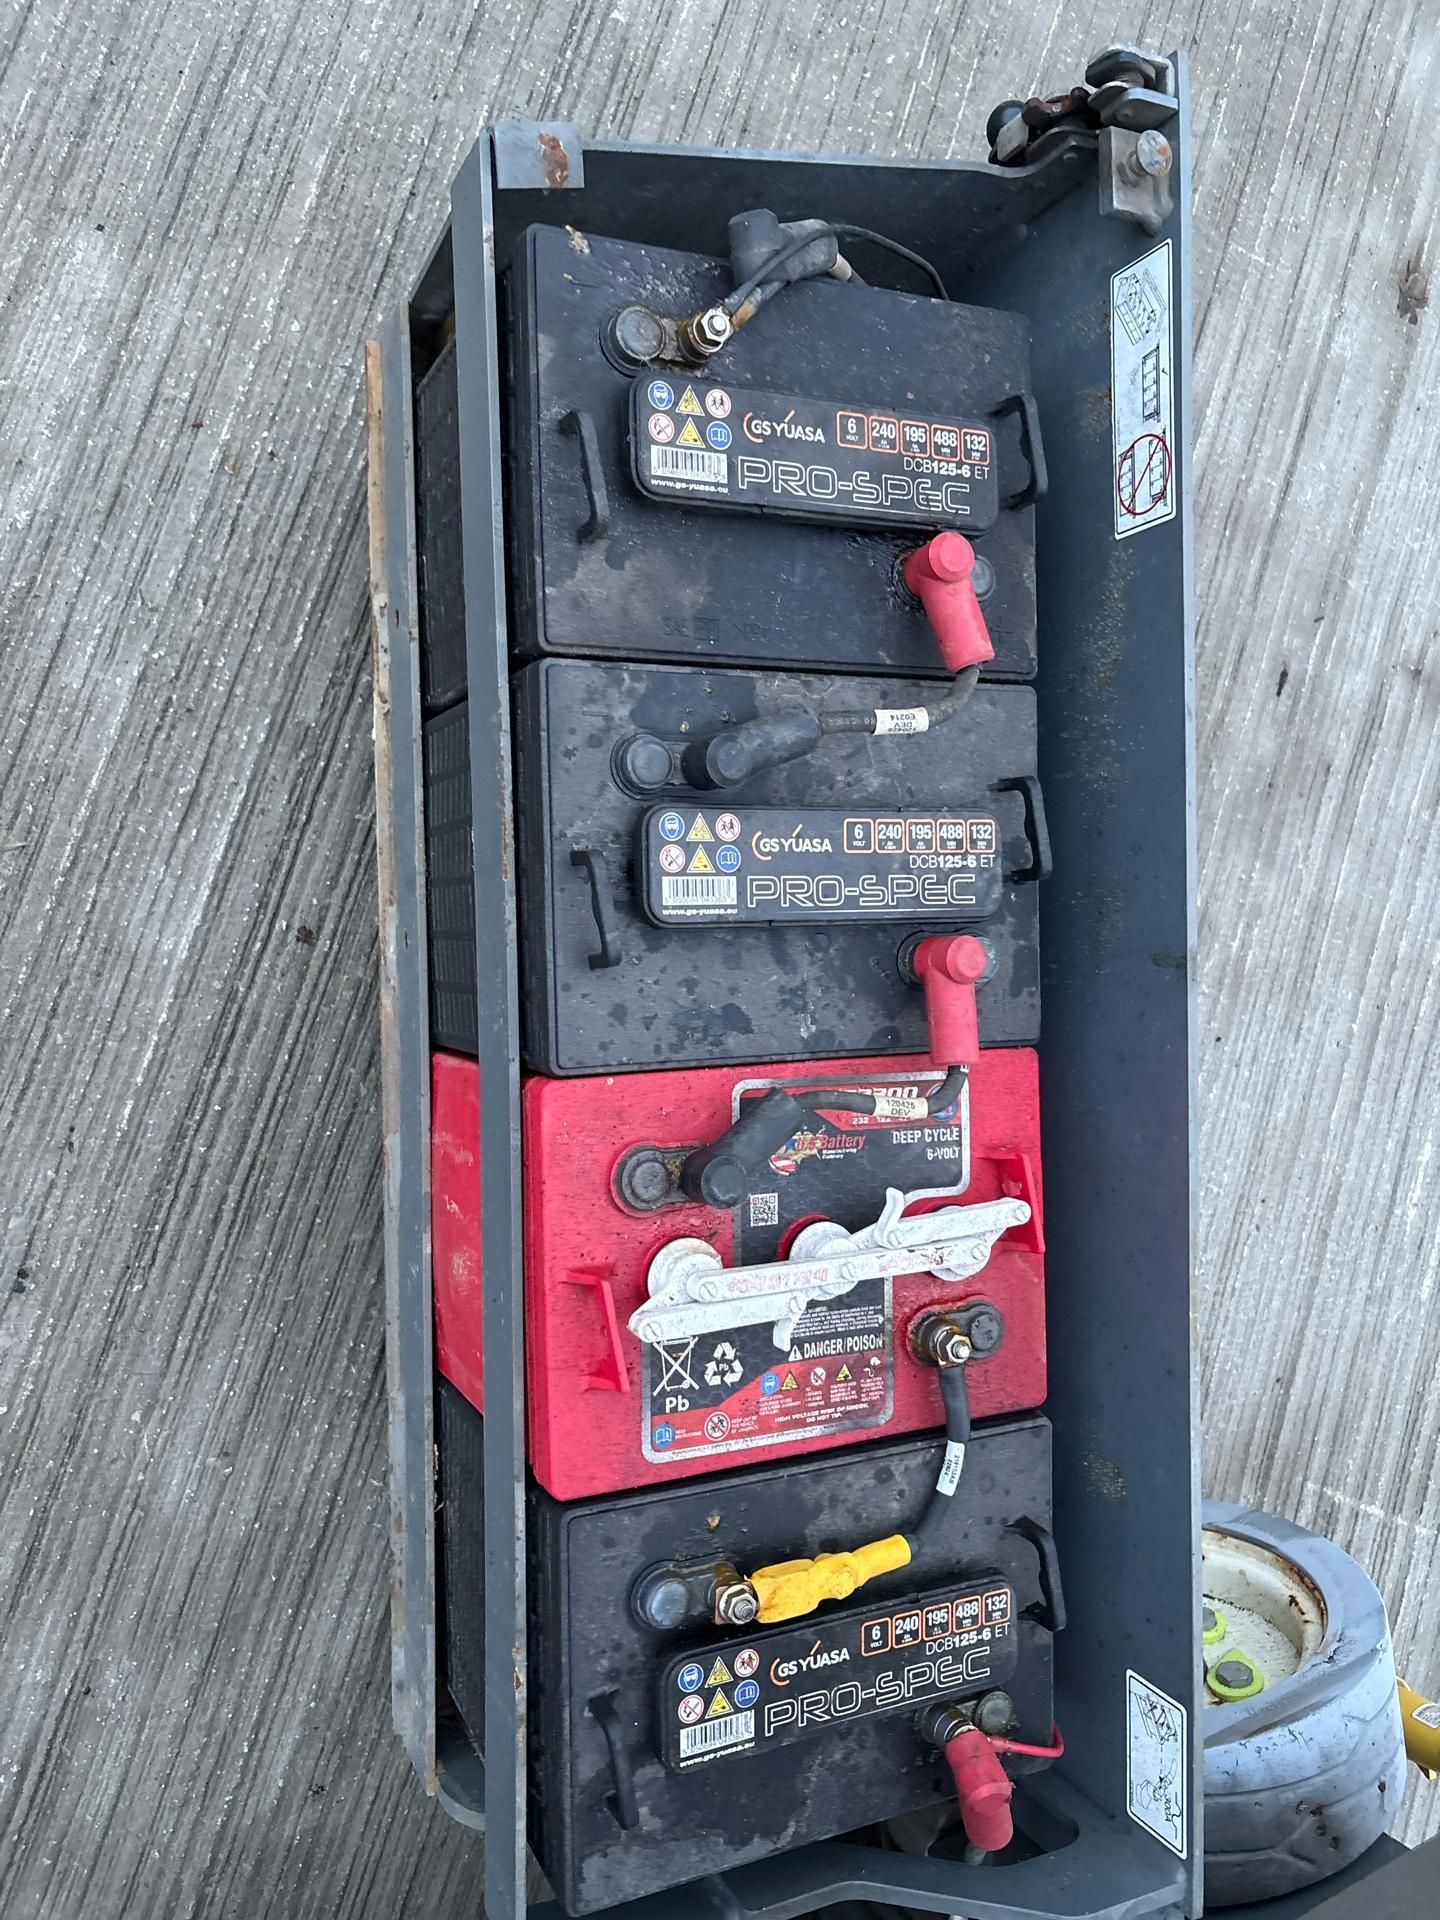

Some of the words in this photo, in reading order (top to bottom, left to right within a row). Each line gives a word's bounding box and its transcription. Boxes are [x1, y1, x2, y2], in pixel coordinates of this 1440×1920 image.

[848, 418, 856, 433] 6
[872, 422, 896, 438] 240
[904, 425, 926, 443] 195
[934, 430, 957, 447] 488
[965, 434, 986, 451] 132
[903, 457, 971, 478] DCB125-6
[975, 466, 990, 480] ET
[738, 455, 970, 515] PRO-SPEC
[854, 824, 864, 839] 6
[878, 824, 902, 839] 240
[910, 824, 932, 839] 195
[940, 824, 963, 839] 488
[971, 824, 992, 839] 132
[910, 855, 977, 869] DCB125-6
[980, 855, 996, 868] ET
[748, 874, 976, 908] PRO-SPEC
[852, 1117, 869, 1125] 232
[891, 1108, 911, 1116] DEV
[820, 1134, 866, 1150] Battery
[892, 1130, 922, 1144] DEEP
[924, 1127, 960, 1143] CYCLE
[927, 1147, 960, 1160] 6-VOLT
[803, 1334, 883, 1359] DANGER/POISON
[719, 1363, 729, 1371] Pb
[665, 1395, 690, 1413] Pb
[872, 1625, 881, 1640] 6
[895, 1616, 919, 1635] 240
[927, 1609, 948, 1626] 195
[956, 1601, 979, 1619] 488
[986, 1594, 1007, 1612] 132
[926, 1627, 992, 1655] DCB125-6
[995, 1622, 1011, 1638] ET
[764, 1646, 990, 1737] PRO-SPEC
